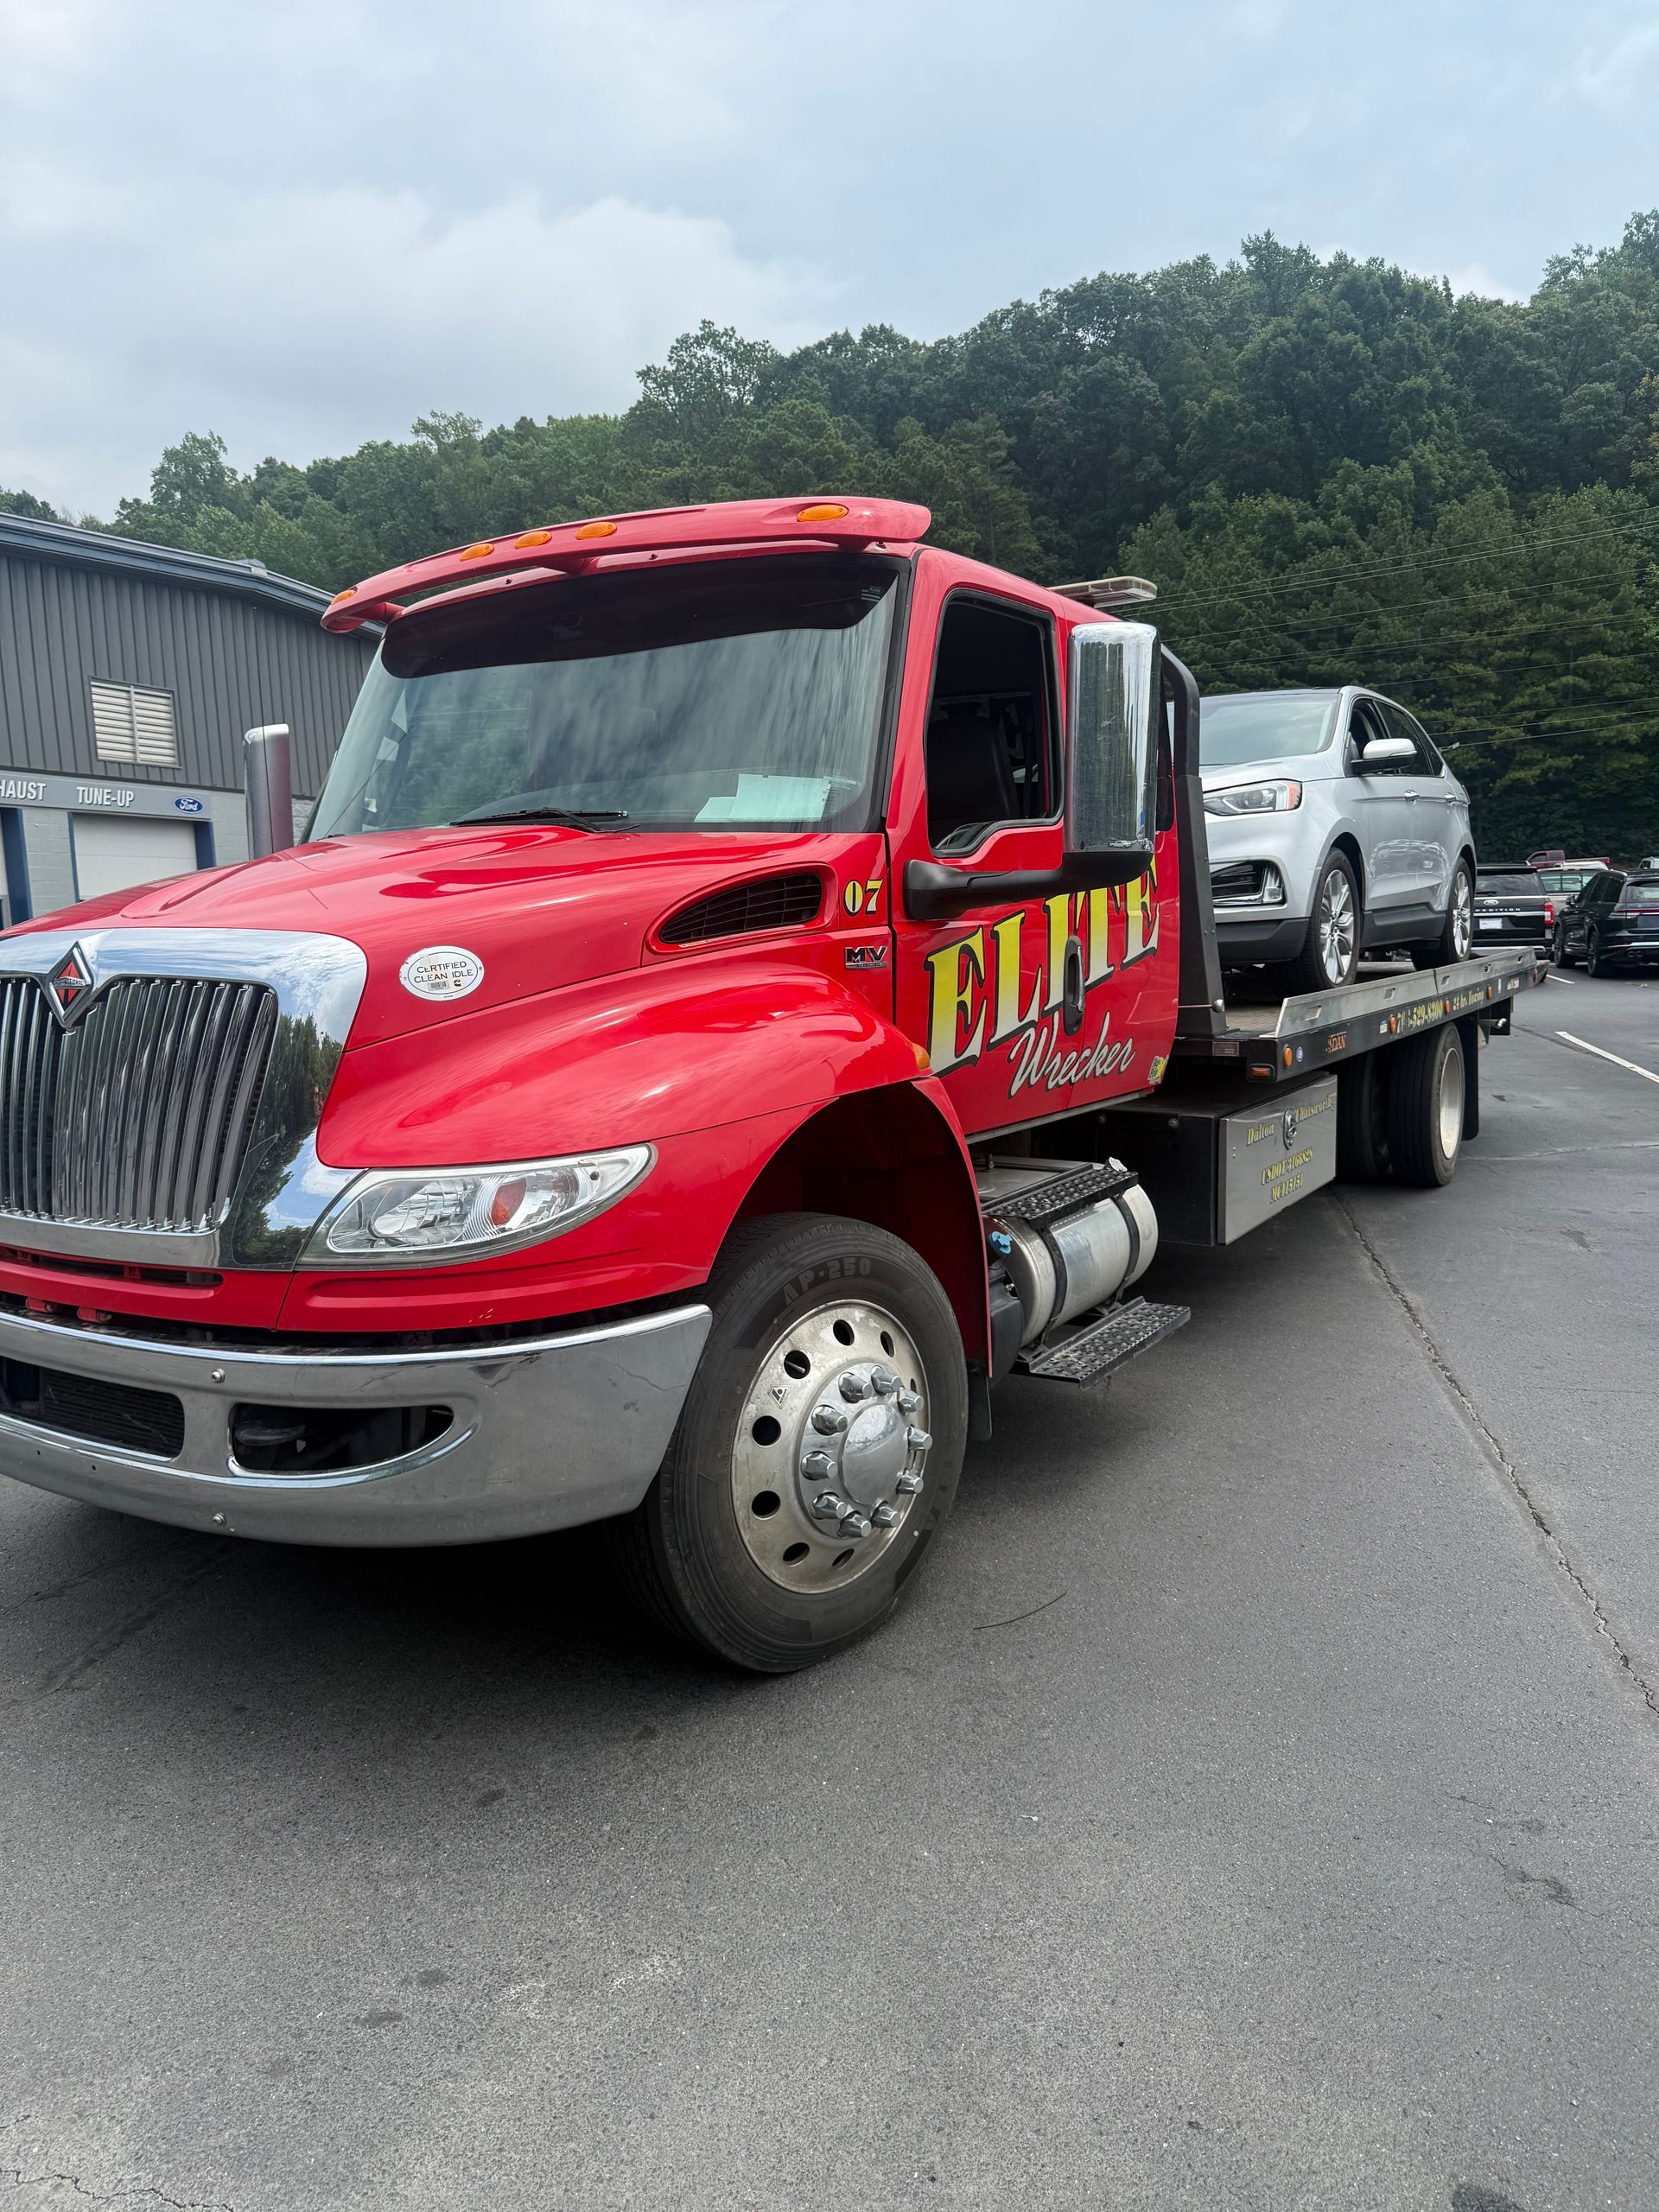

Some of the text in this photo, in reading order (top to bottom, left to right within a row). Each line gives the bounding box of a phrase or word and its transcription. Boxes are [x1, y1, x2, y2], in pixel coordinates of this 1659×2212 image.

[77, 786, 134, 808] TUNE-UP
[177, 798, 200, 812] Ford
[843, 879, 883, 917] 07
[845, 946, 887, 963] MV
[414, 969, 474, 983] CLEAN IDLE
[416, 961, 467, 974] CERTIFIED
[924, 854, 1160, 1078] ELITE
[1007, 1010, 1135, 1098] Wrecker
[1247, 1124, 1274, 1147] Dalton
[783, 1256, 872, 1307] AP-250
